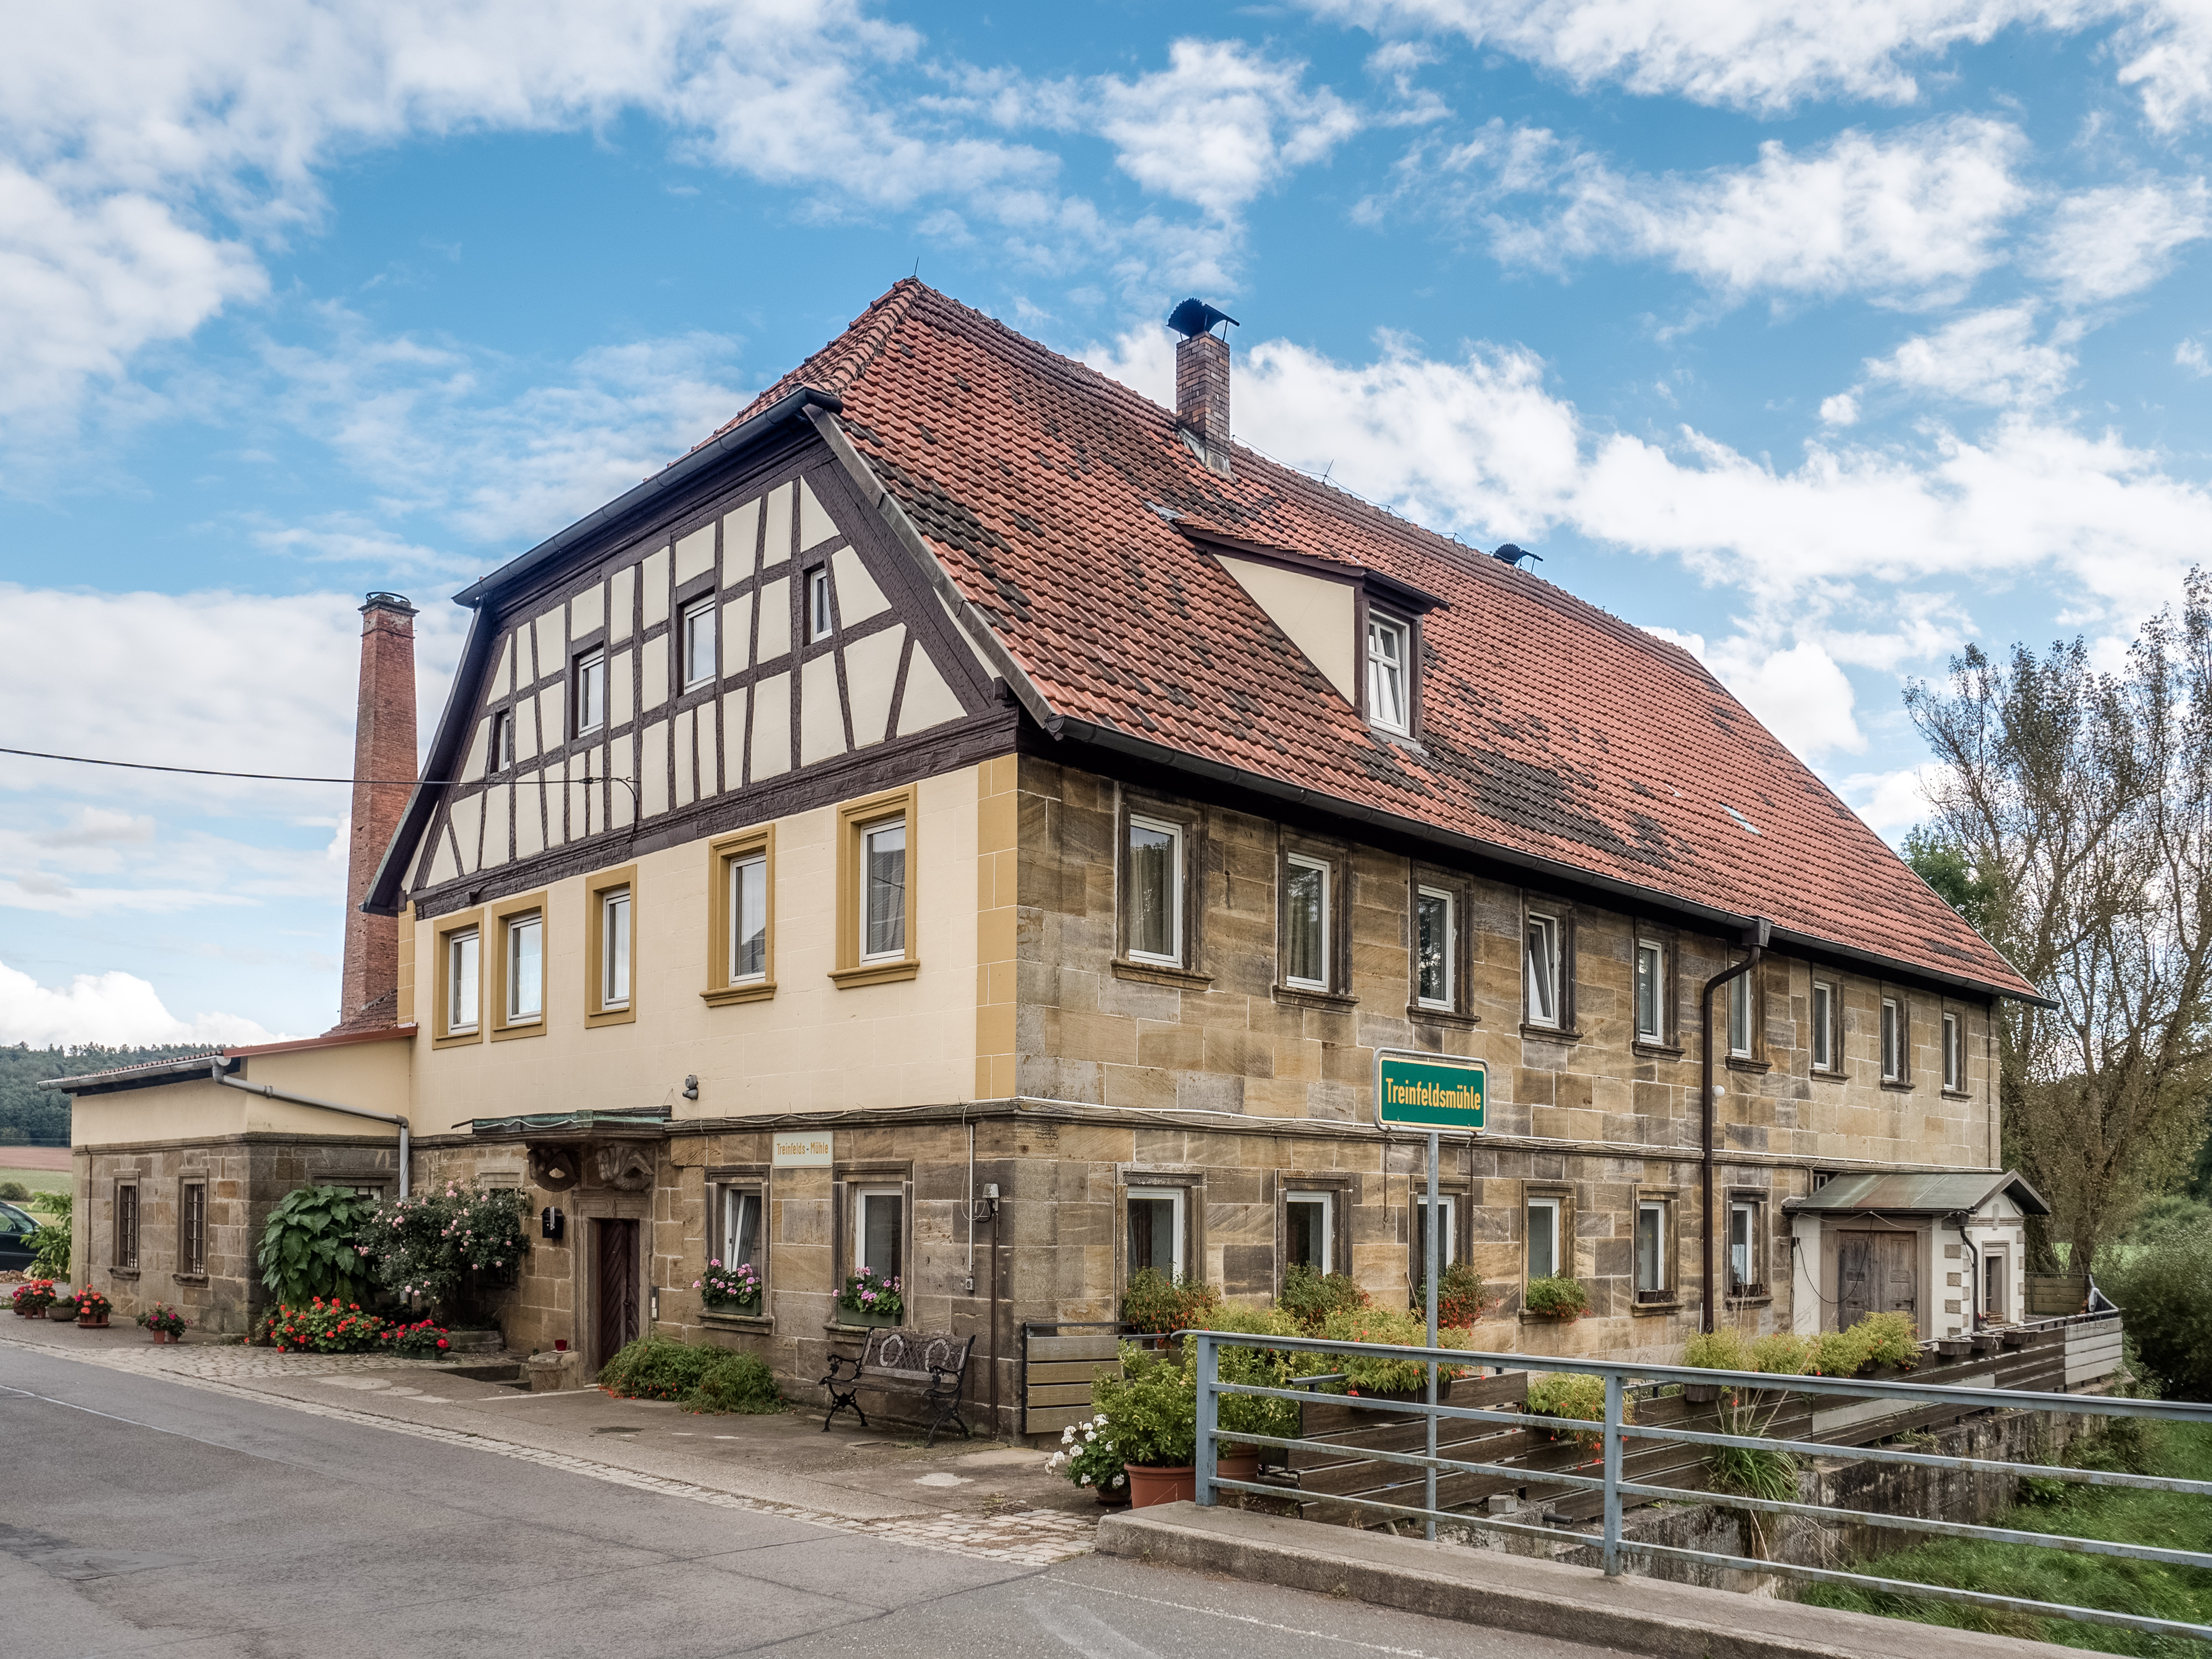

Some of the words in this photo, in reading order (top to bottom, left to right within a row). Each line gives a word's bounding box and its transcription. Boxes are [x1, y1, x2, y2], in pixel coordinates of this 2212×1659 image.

[1385, 1077, 1481, 1110] Treinfeldsmühle
[777, 1142, 805, 1155] Treinfelds
[810, 1142, 829, 1154] Mühle
